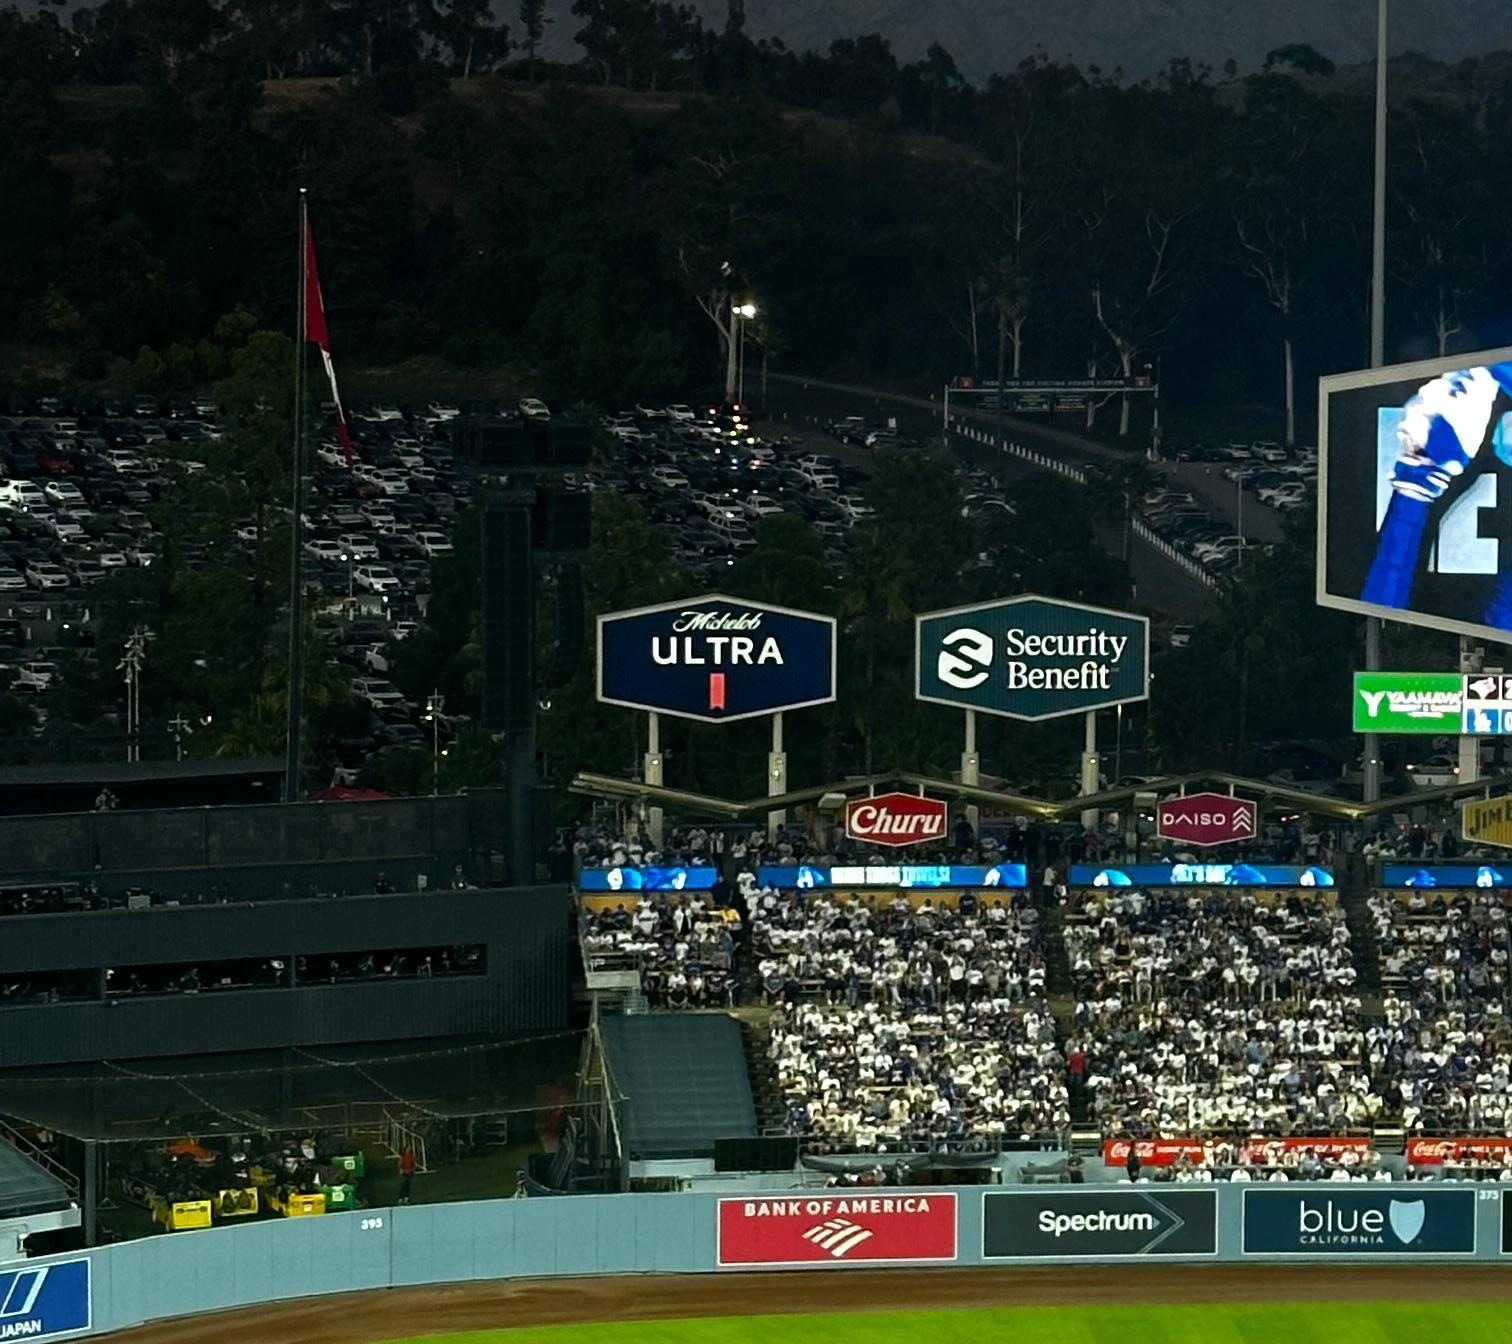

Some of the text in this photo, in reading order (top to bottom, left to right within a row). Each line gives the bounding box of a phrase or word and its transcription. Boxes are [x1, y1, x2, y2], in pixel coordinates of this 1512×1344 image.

[672, 611, 763, 632] Michelob
[652, 636, 784, 665] ULTRA
[1006, 628, 1128, 663] Security
[1007, 661, 1112, 689] Benefit
[851, 806, 943, 834] Churu
[1163, 813, 1226, 826] DAISO
[1469, 808, 1503, 836] JIM
[1479, 1190, 1499, 1200] 375
[744, 1198, 931, 1217] BANK OF AMERICA
[1300, 1200, 1384, 1233] blue
[361, 1217, 383, 1230] 395
[1039, 1210, 1153, 1237] Spectrum
[1300, 1235, 1385, 1244] CALIFORNIA
[0, 1319, 42, 1339] JAPAN
